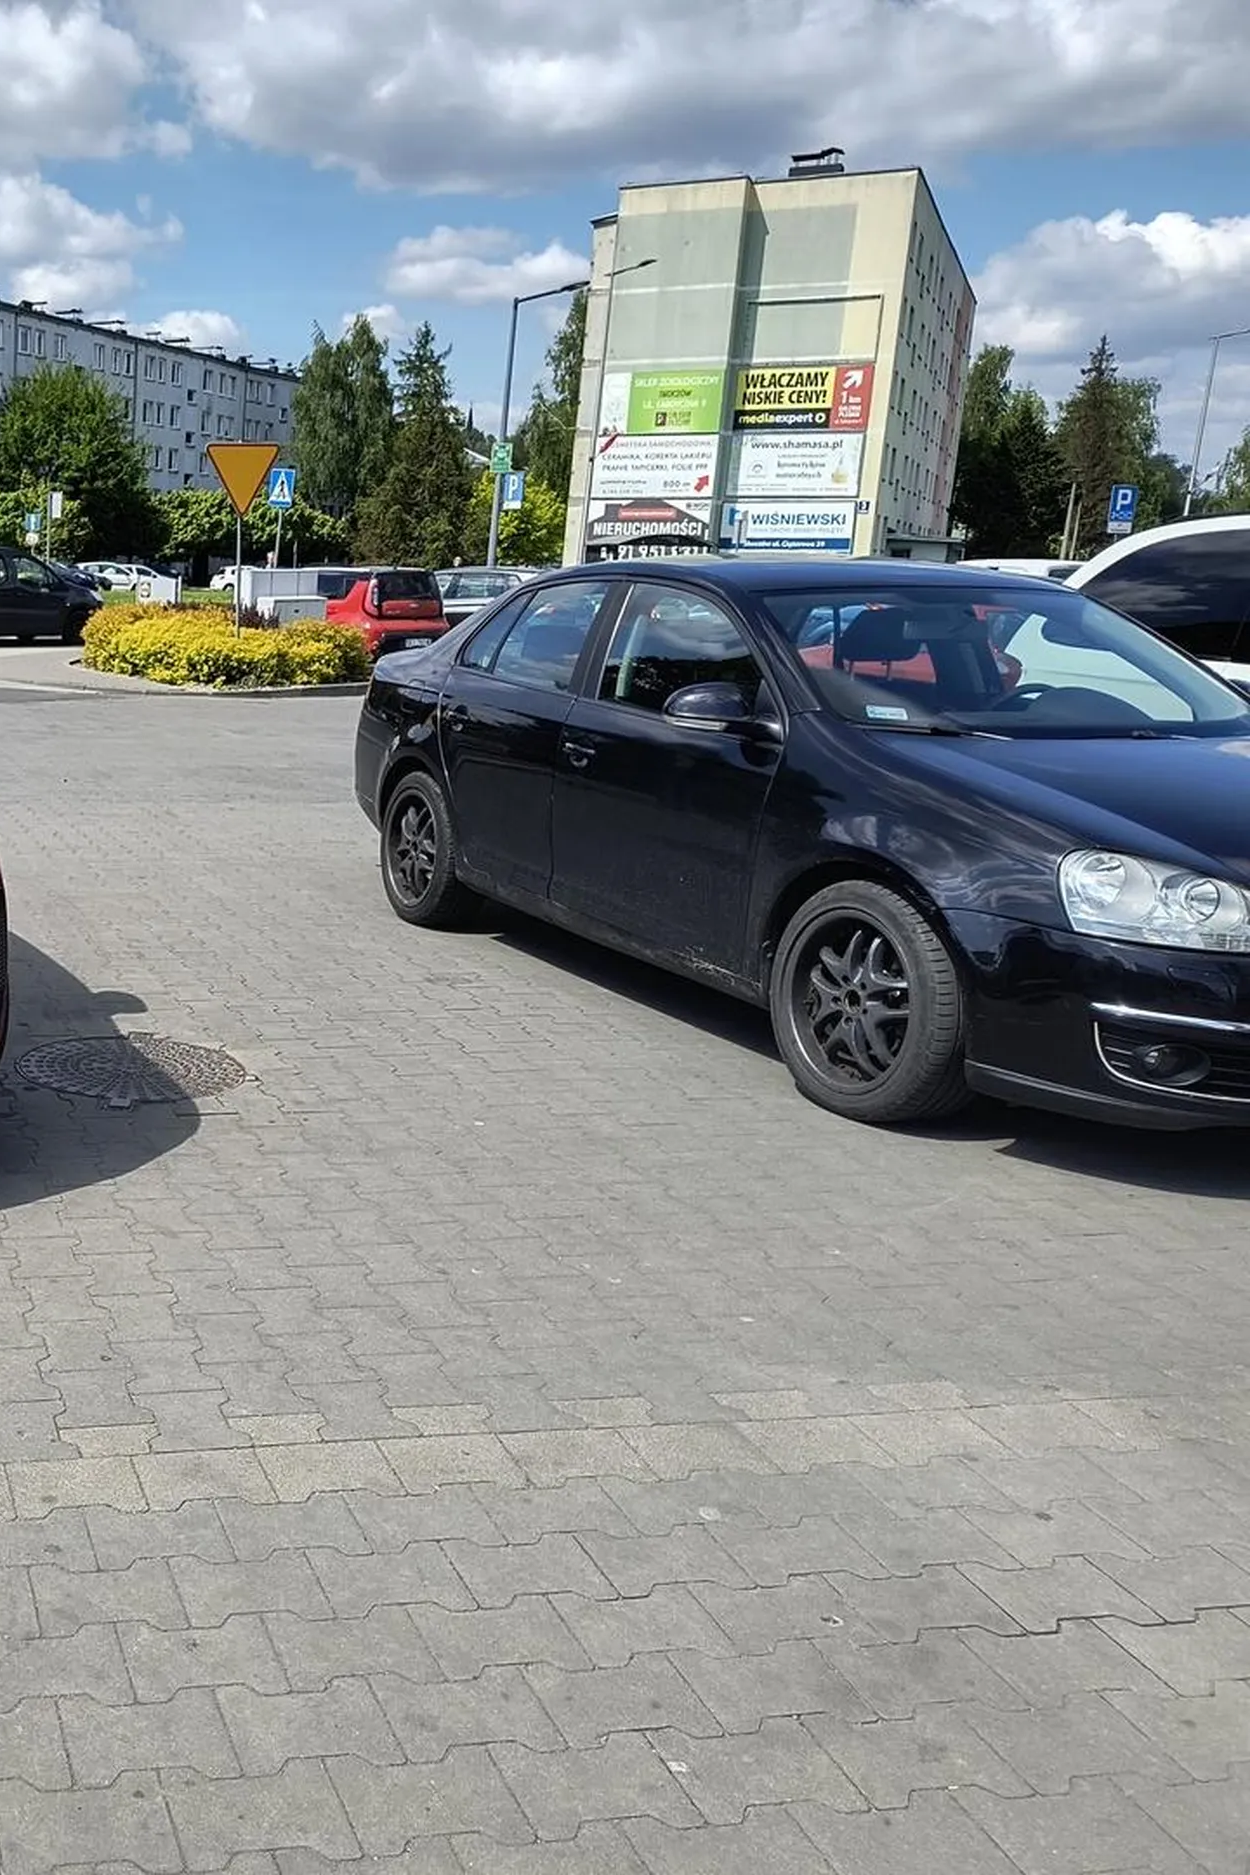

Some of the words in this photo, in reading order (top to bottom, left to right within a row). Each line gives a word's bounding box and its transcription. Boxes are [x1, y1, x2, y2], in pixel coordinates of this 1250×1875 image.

[742, 390, 784, 406] NISKIE
[788, 389, 828, 404] CENY!
[739, 412, 813, 425] mediaexpert
[750, 439, 844, 451] www.shamasa.pl
[1116, 489, 1132, 511] P
[751, 512, 846, 526] WIŚNIEWSKI
[593, 518, 702, 536] NIERUCHOMOŚCI
